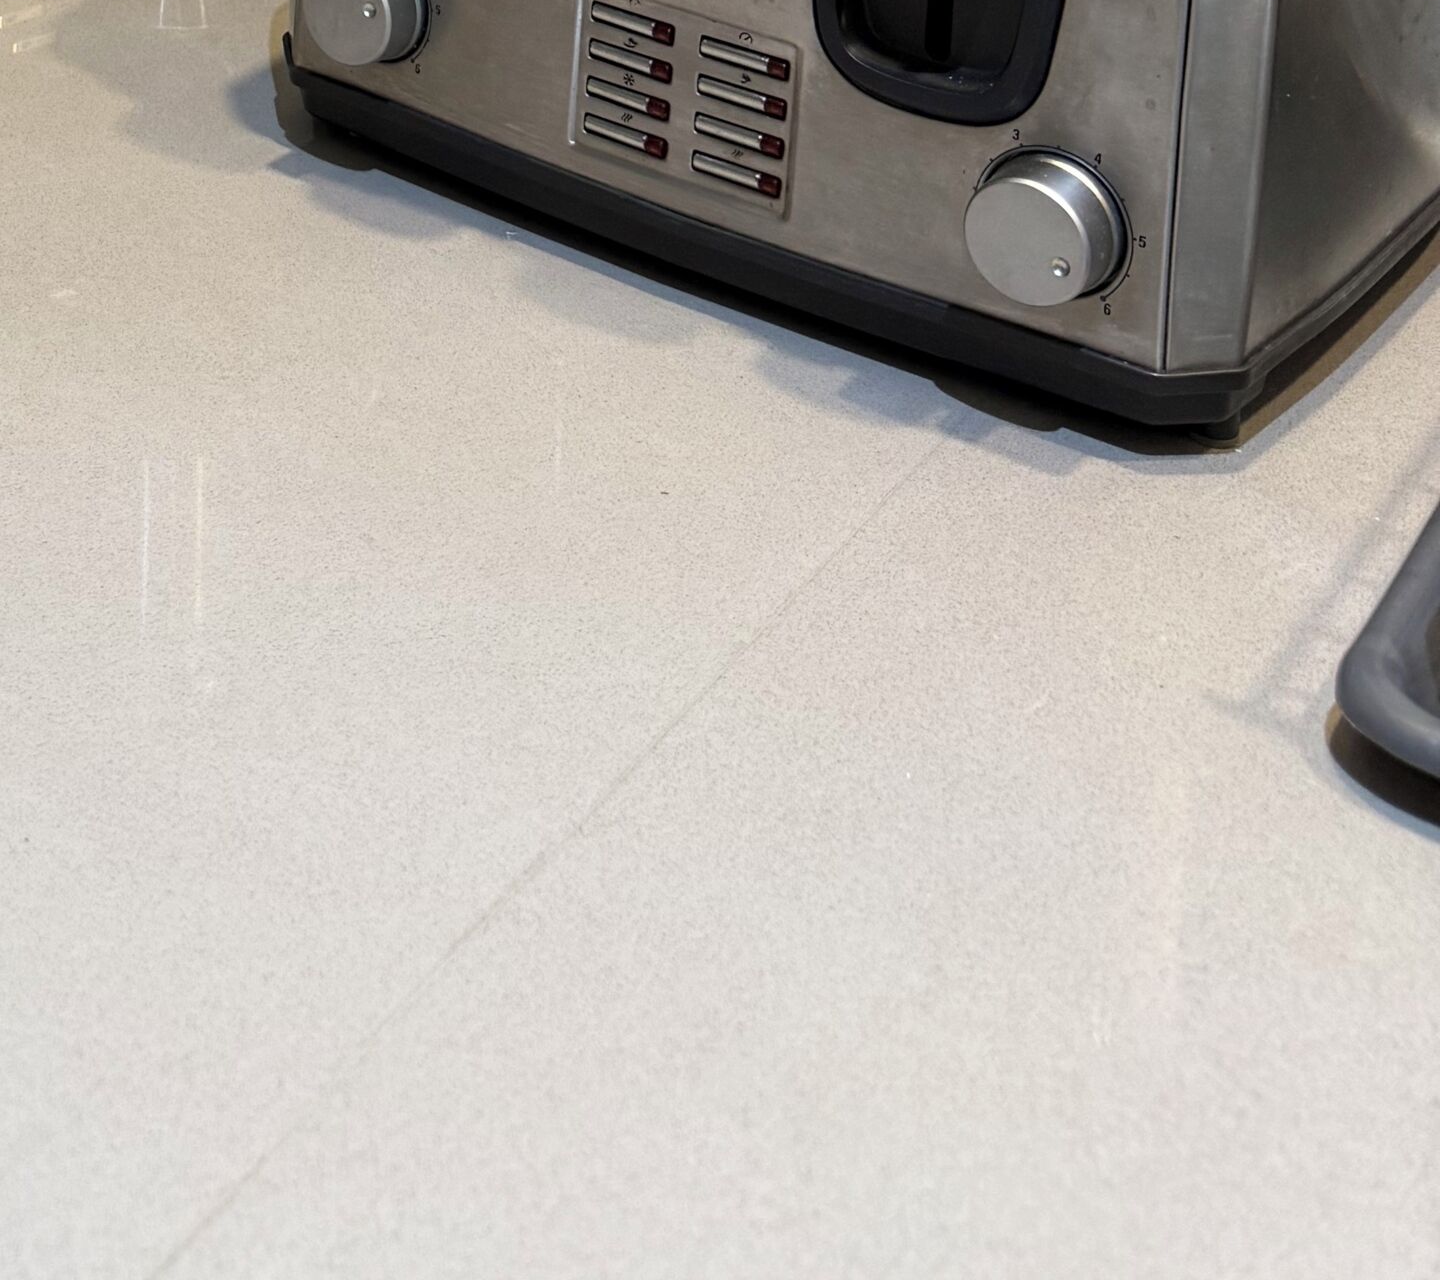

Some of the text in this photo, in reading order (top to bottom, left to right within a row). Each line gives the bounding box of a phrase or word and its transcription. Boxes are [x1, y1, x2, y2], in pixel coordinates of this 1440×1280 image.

[435, 4, 441, 15] 5
[1012, 129, 1147, 316] 3 4 5 6
